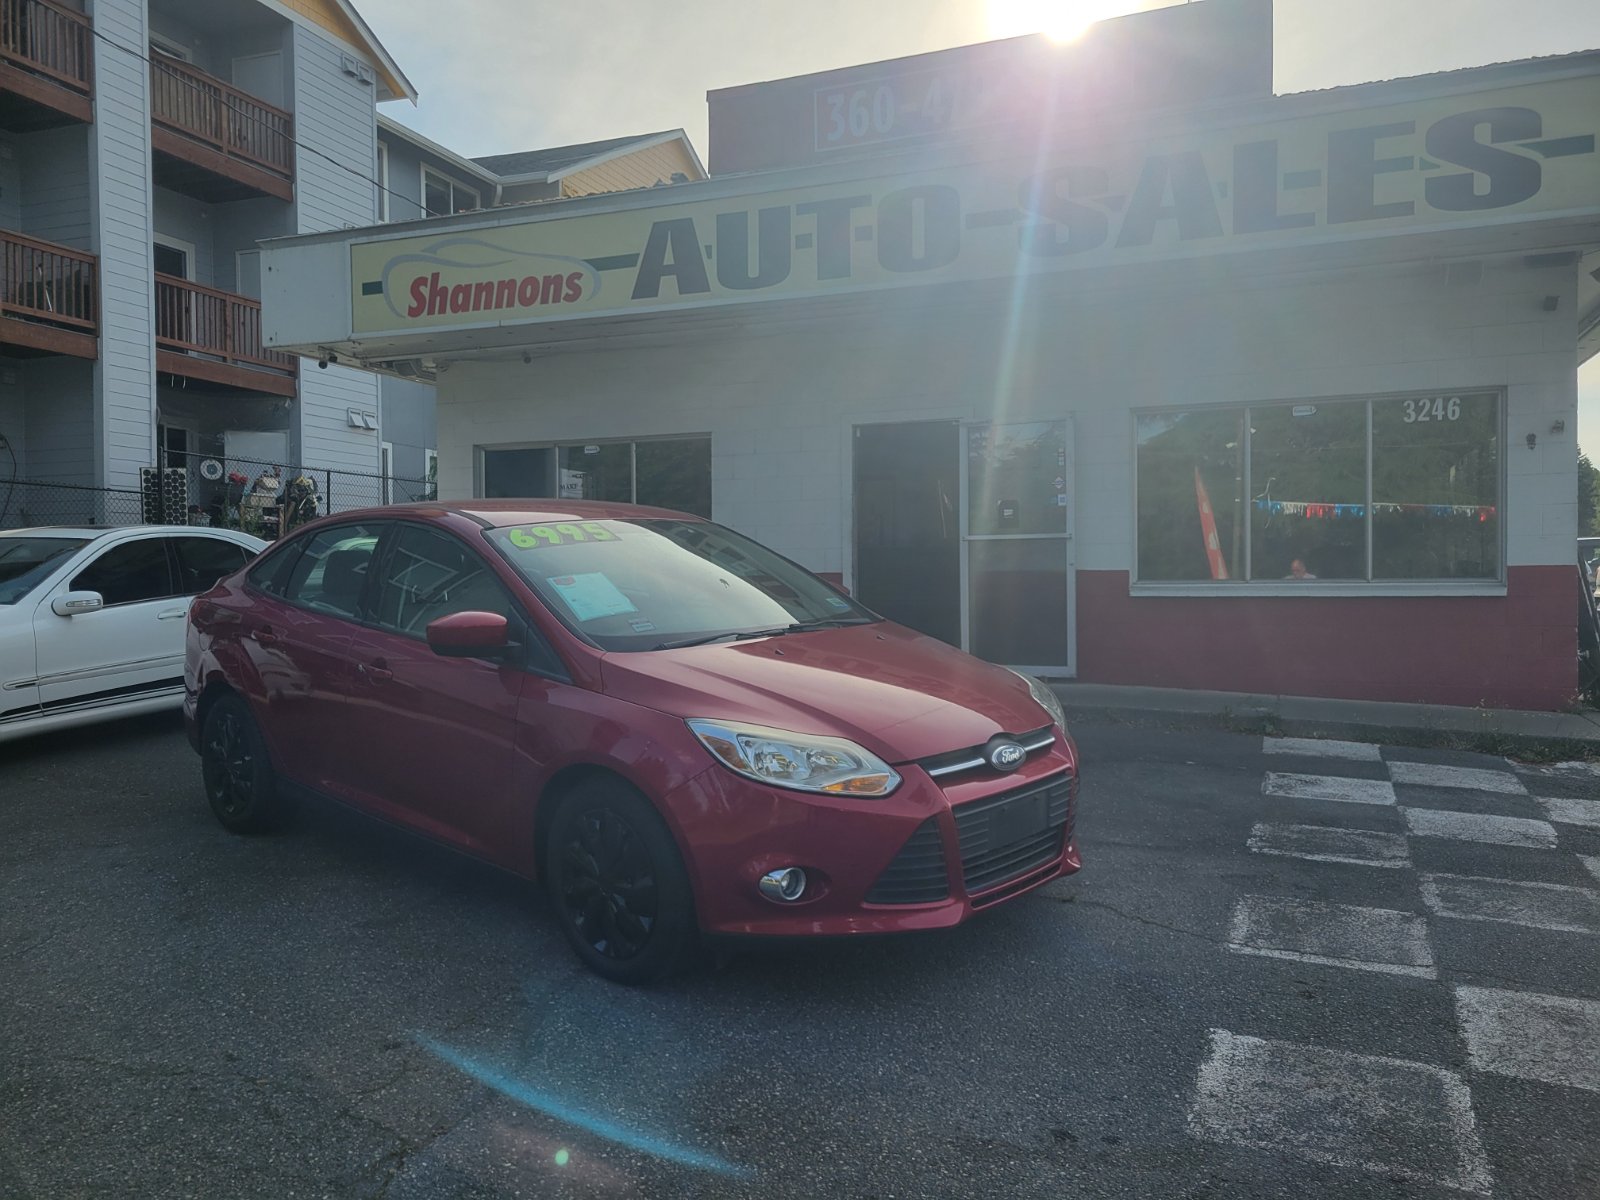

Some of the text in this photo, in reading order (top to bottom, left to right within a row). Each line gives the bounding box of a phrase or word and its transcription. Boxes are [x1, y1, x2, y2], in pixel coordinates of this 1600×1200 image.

[407, 107, 1541, 318] Shannons AUTO SALES
[1403, 397, 1461, 423] 3246
[510, 523, 614, 548] 6995
[1001, 749, 1020, 763] Ford
